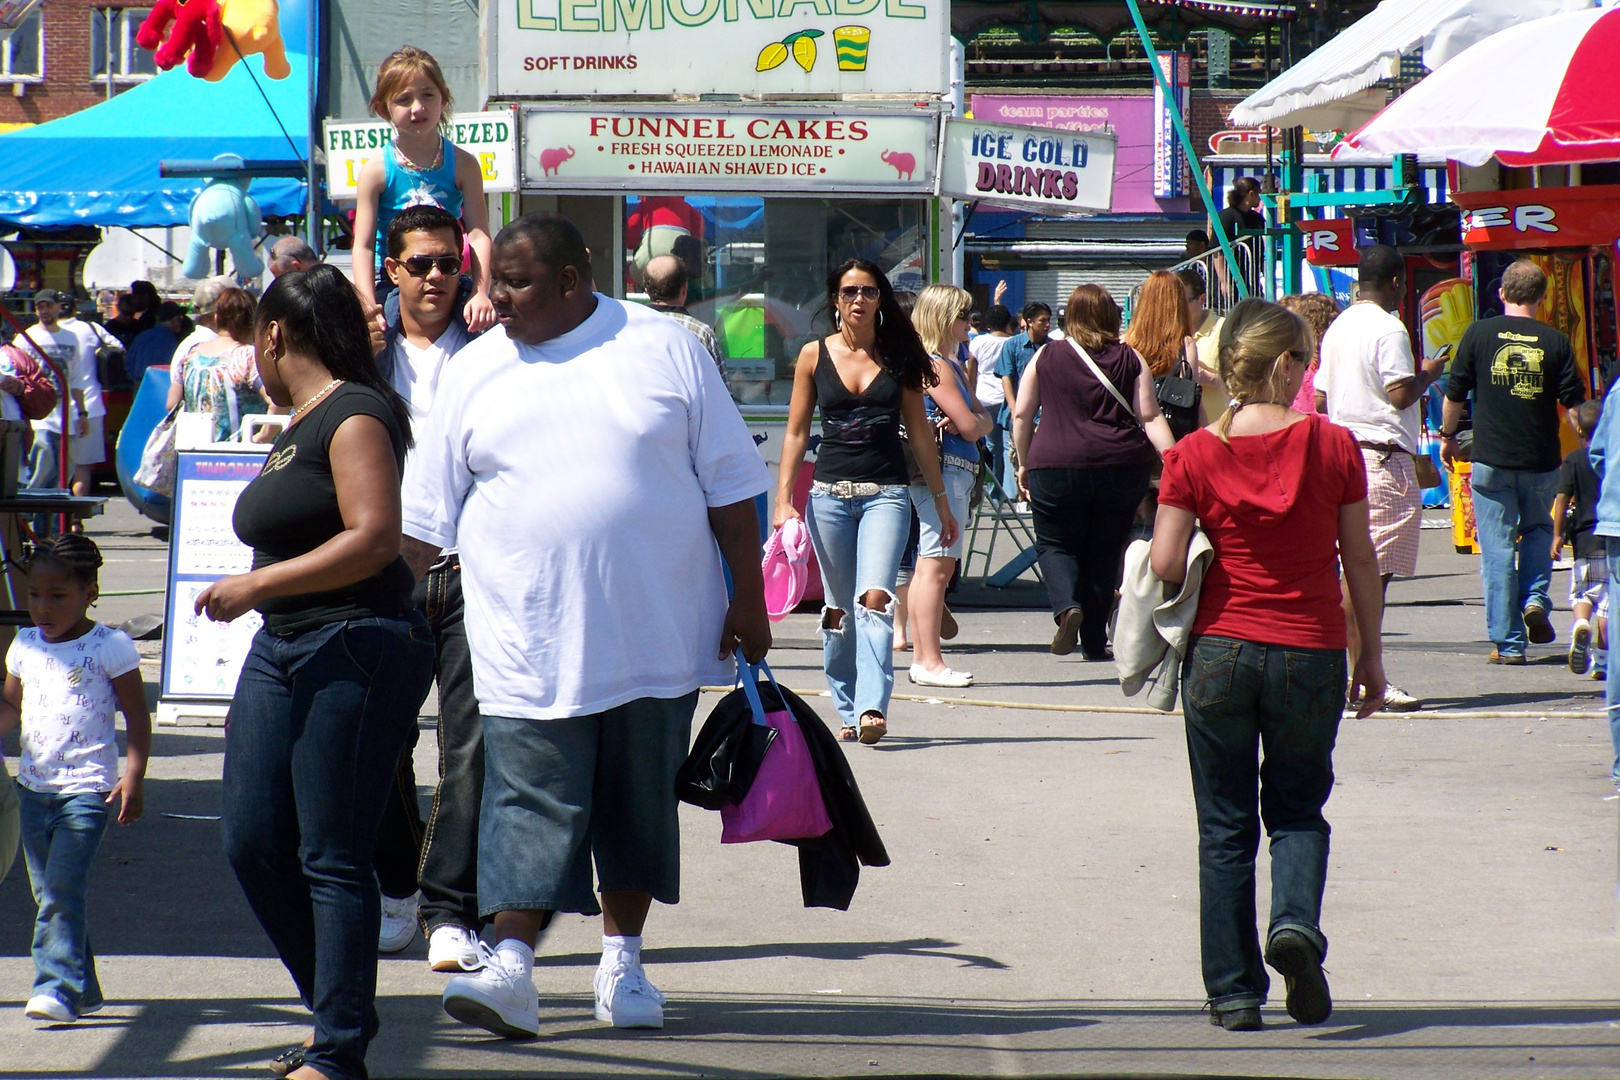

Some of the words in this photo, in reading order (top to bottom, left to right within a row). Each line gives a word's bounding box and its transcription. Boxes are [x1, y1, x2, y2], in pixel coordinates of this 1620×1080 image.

[517, 0, 926, 32] LEMO
[523, 57, 570, 71] SOFT
[573, 54, 638, 70] DRINKS
[999, 105, 1043, 117] team
[1047, 105, 1108, 119] parties
[589, 117, 735, 138] FUNNEL
[747, 119, 868, 141] CAKES
[329, 128, 393, 150] FRESH
[971, 128, 1013, 160] ICE
[1022, 133, 1089, 168] COLD
[611, 143, 661, 155] FRESH
[665, 144, 747, 158] SQUEEZED
[750, 145, 833, 158] LEMONADE
[641, 161, 721, 174] HAWAIIAN
[724, 162, 788, 175] SHAVED
[792, 163, 817, 175] ICE
[975, 161, 1079, 201] DRINKS
[195, 461, 264, 478] TEMPORAR
